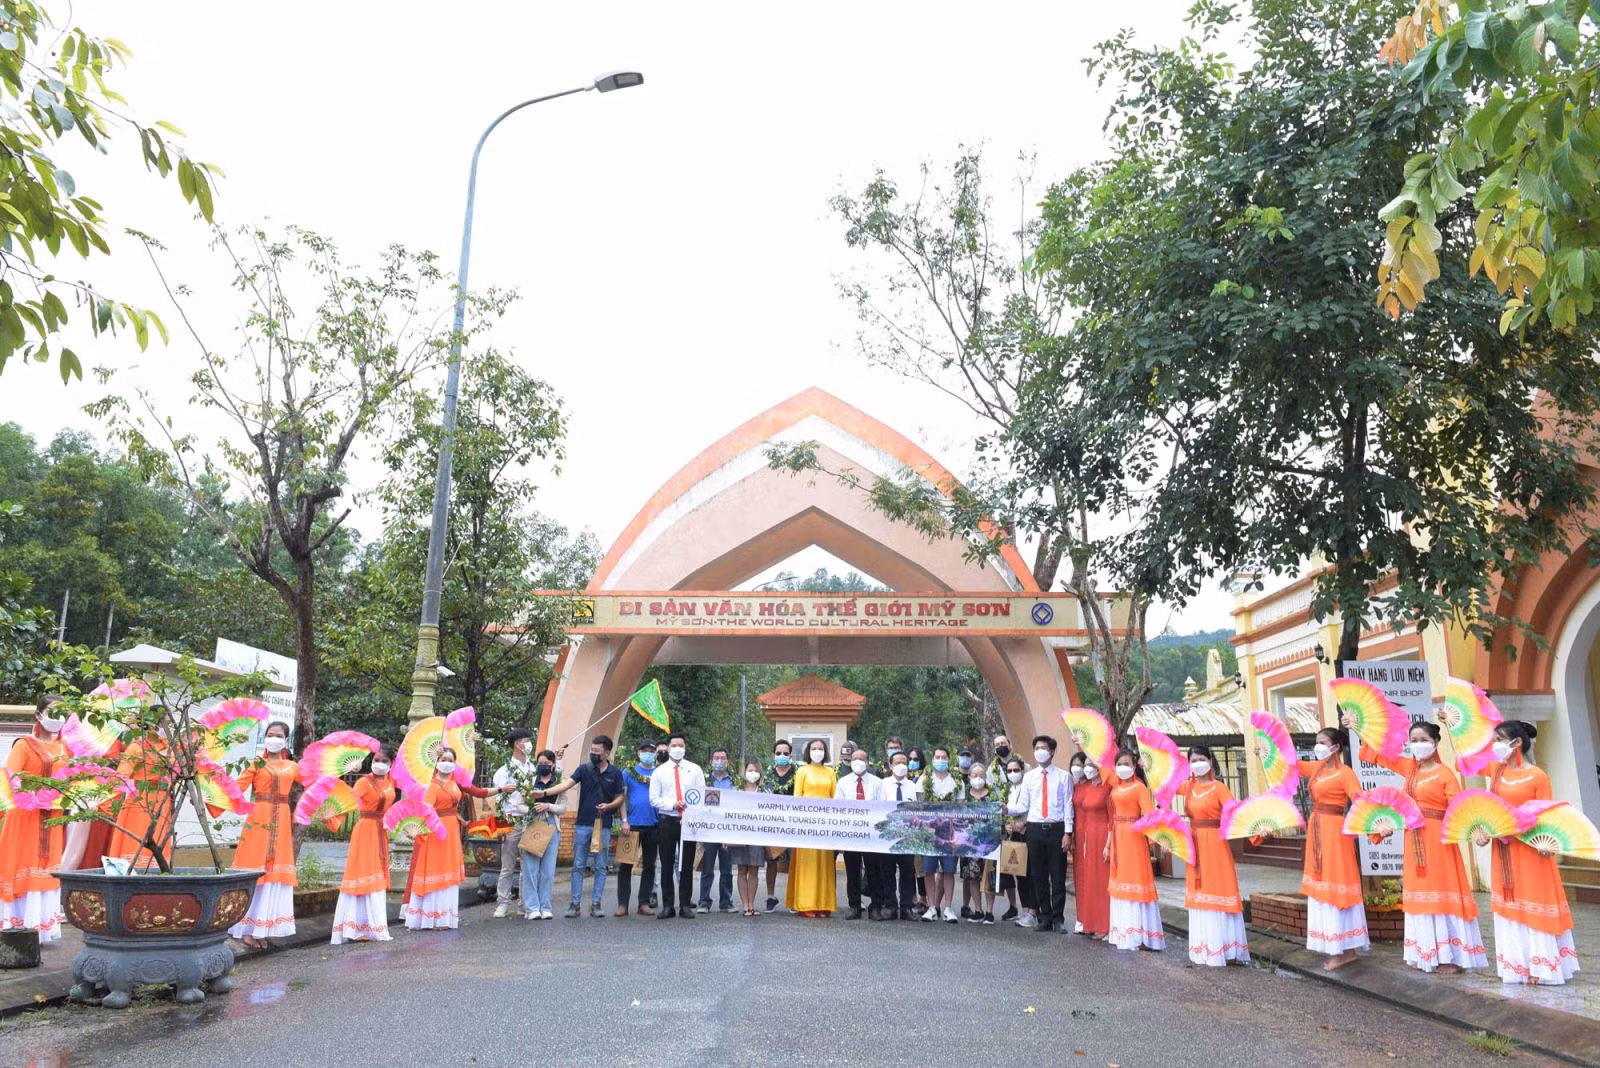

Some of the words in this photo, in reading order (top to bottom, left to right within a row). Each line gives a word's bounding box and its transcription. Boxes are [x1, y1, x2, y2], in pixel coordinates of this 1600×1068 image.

[619, 601, 642, 616] DI
[751, 618, 804, 626] WORLD
[758, 802, 790, 811] WARMLY
[792, 804, 830, 814] WELCOME
[848, 808, 870, 816] FIRST
[724, 812, 786, 822] INTERNATIONAL
[788, 816, 826, 824] TOURISTS
[688, 822, 716, 830] WORLD
[716, 823, 755, 832] CULTURAL
[758, 826, 796, 835] HERITAGE
[808, 829, 830, 837] PILOT
[832, 830, 870, 839] PROGRAM
